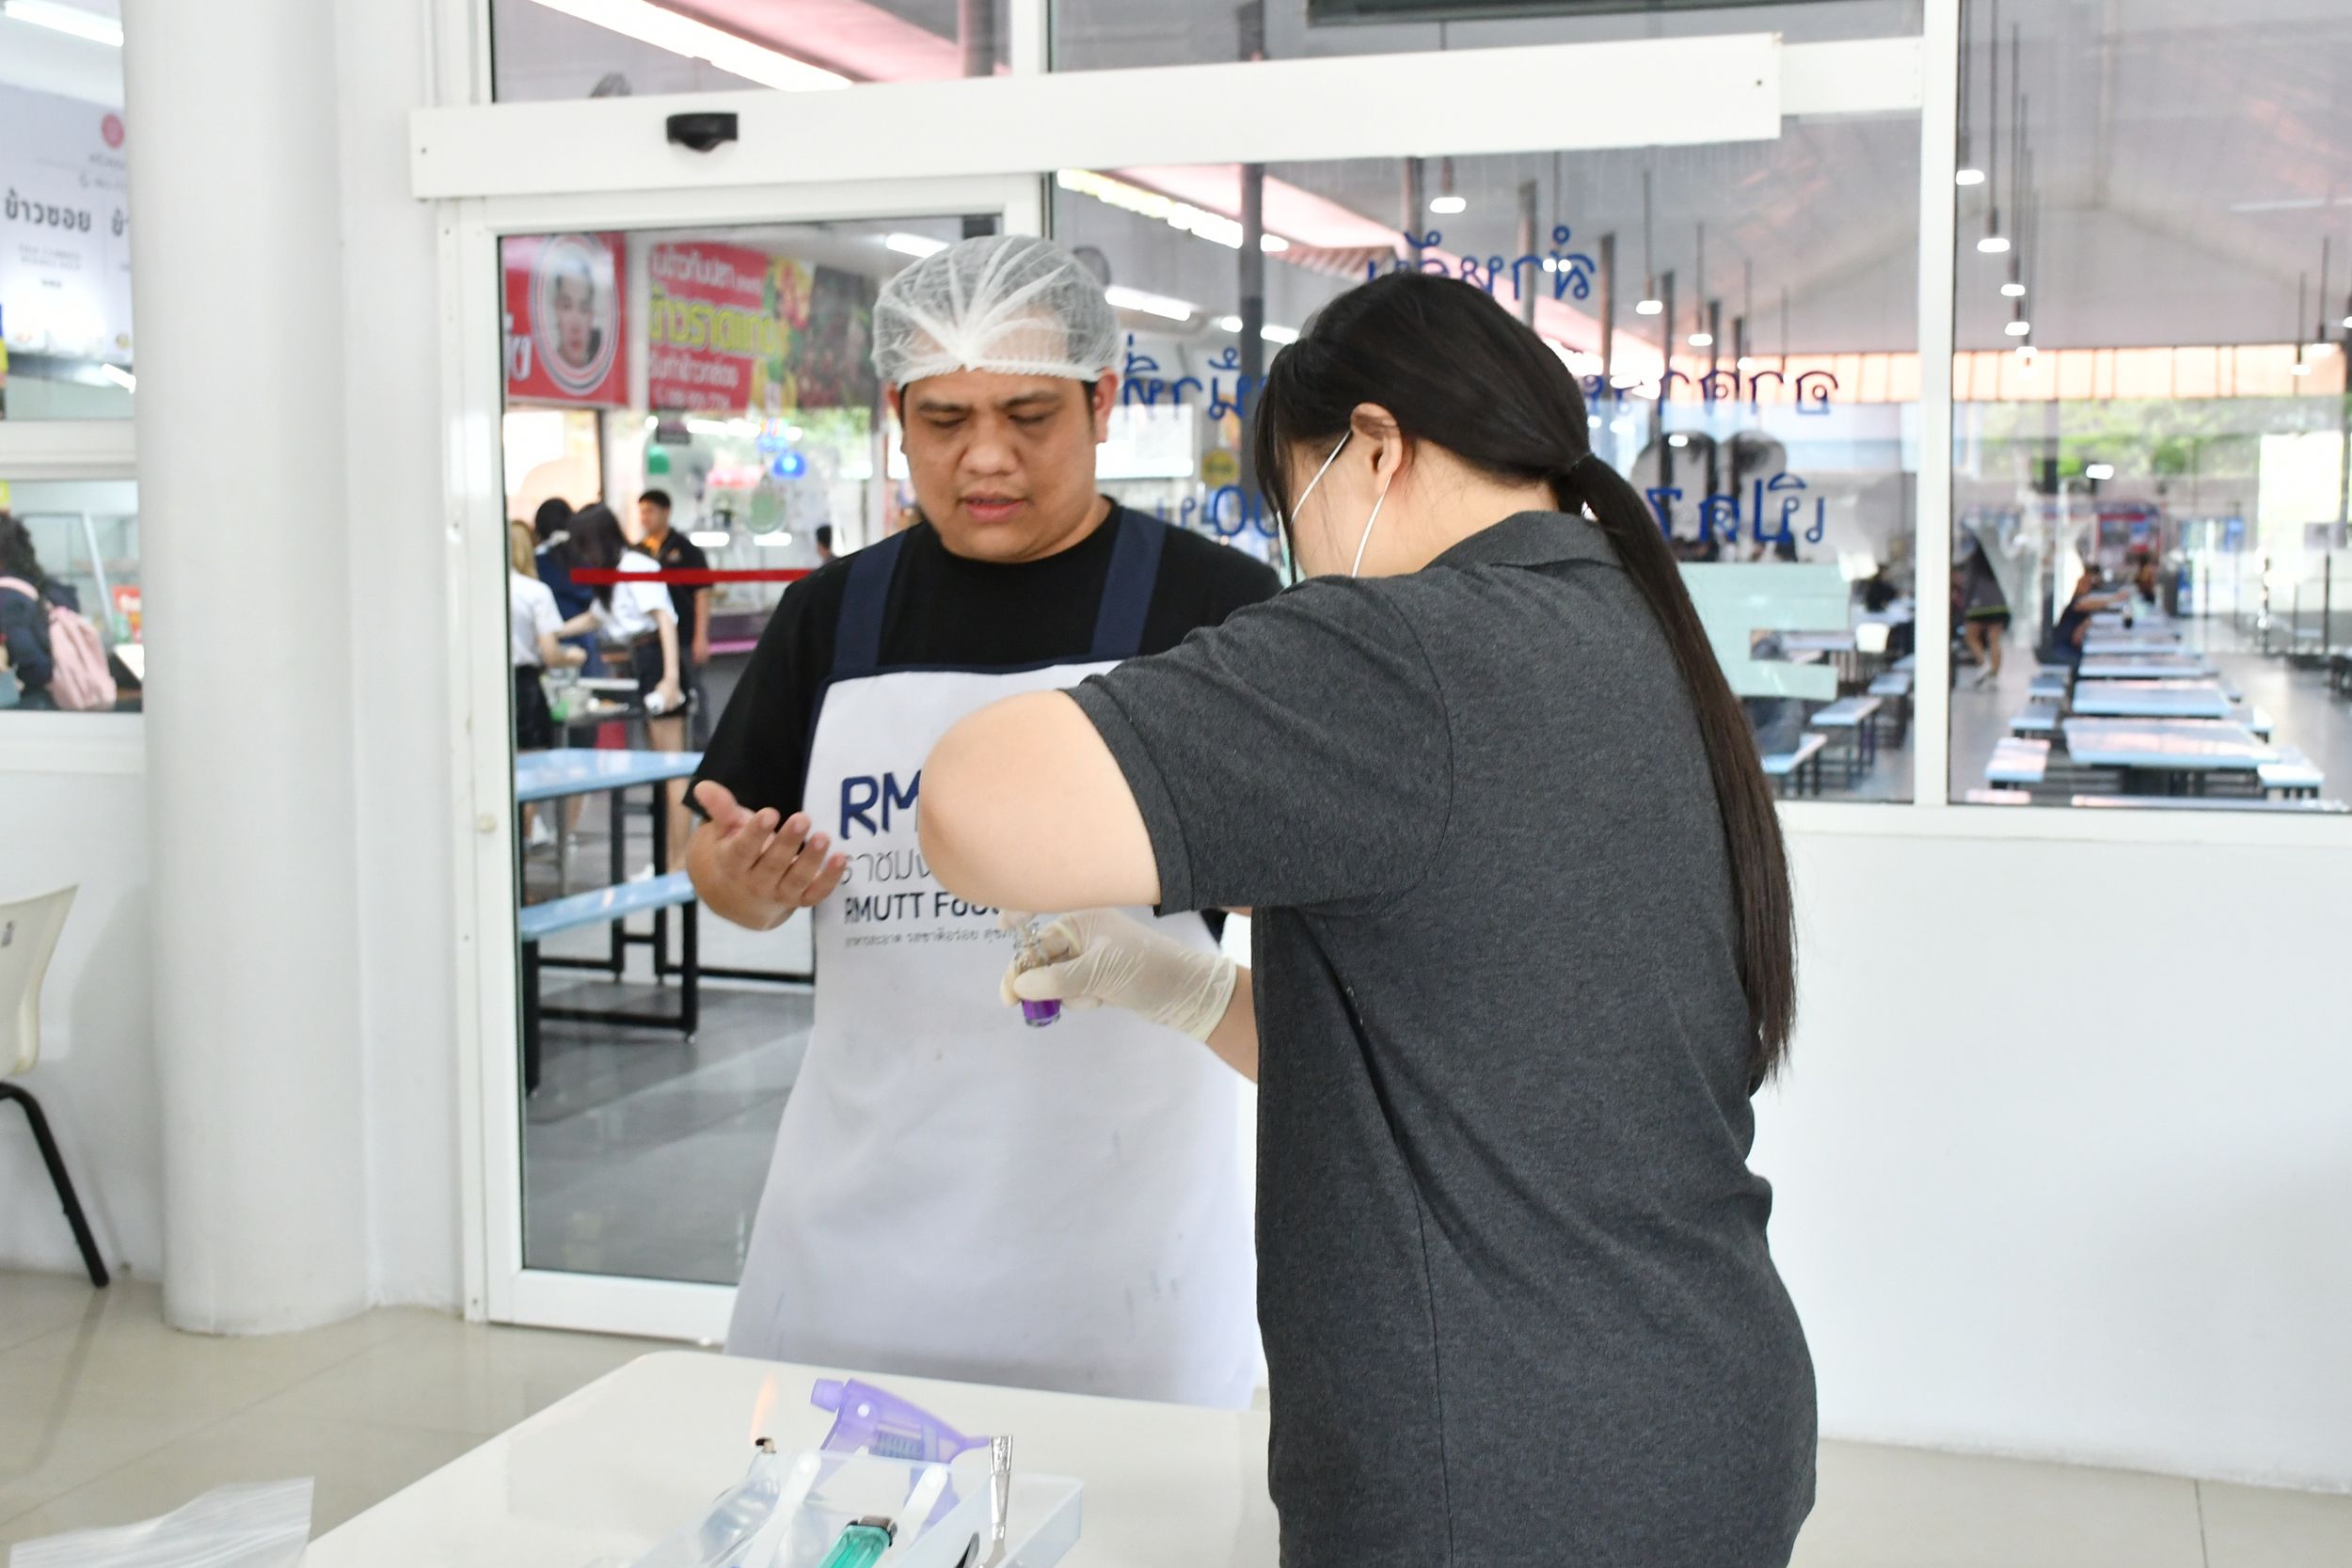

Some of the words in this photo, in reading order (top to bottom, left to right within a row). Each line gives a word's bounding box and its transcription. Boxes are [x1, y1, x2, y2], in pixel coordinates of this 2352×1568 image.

[6, 187, 91, 231] ข้าวซอย
[111, 208, 129, 237] ข้
[840, 769, 921, 840] RM
[844, 892, 924, 925] RMUTT
[935, 892, 999, 918] Foo
